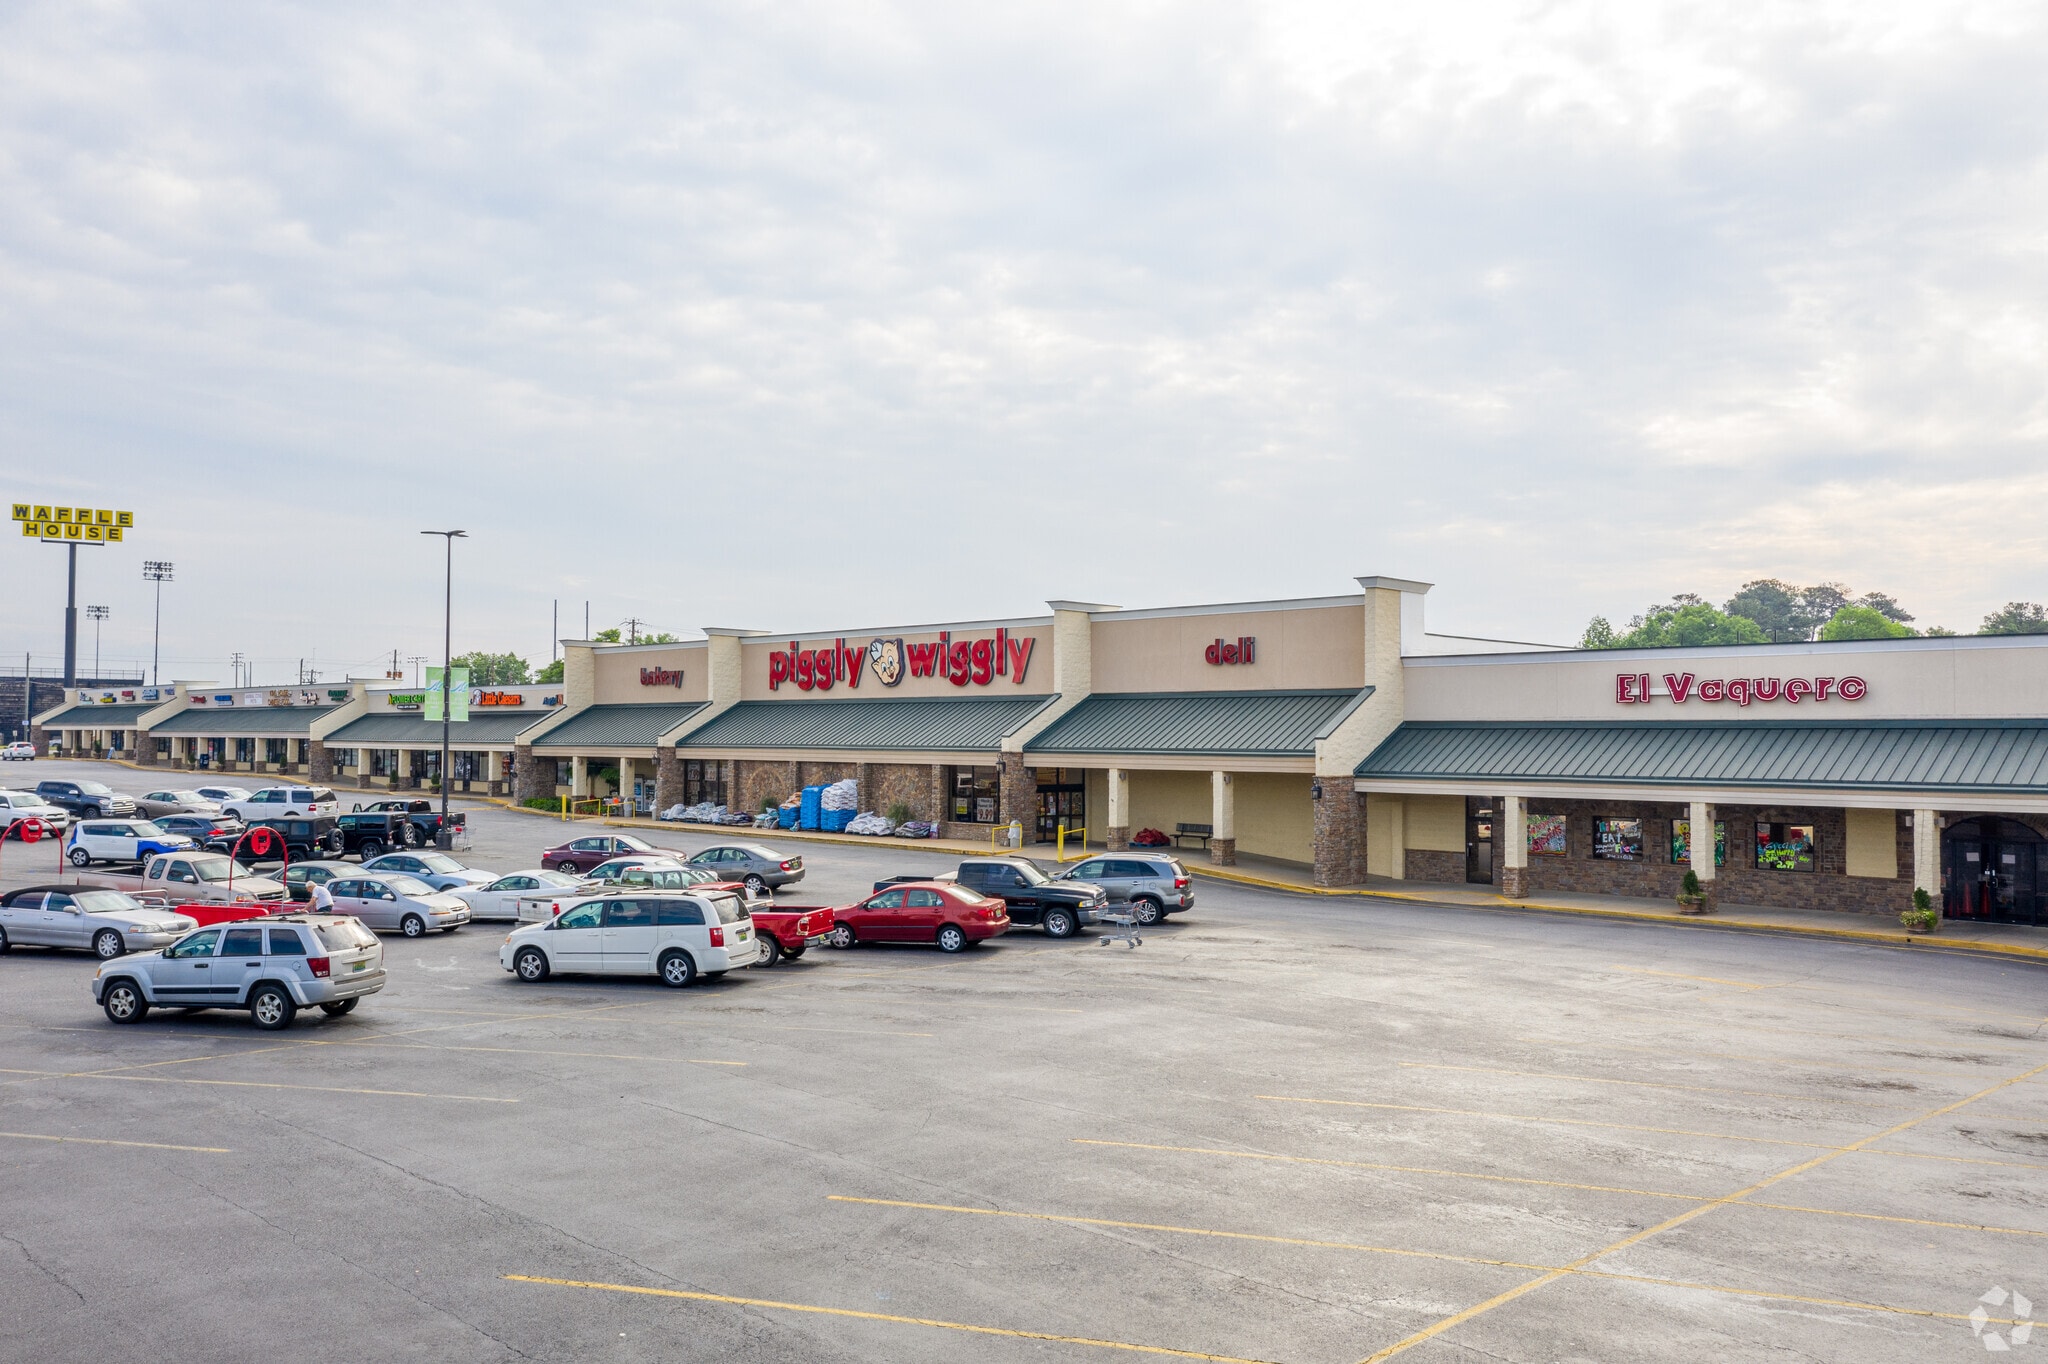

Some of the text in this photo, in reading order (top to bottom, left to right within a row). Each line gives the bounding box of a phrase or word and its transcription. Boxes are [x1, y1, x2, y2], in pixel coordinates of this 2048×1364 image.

[14, 505, 130, 525] WAFFLE
[25, 523, 120, 540] HOUSE
[769, 628, 1035, 691] piggly wiggly
[1205, 637, 1255, 665] deli
[640, 666, 684, 689] bakery
[1616, 672, 1867, 706] El Vaquero
[481, 691, 497, 706] Little
[498, 691, 521, 706] Caesars
